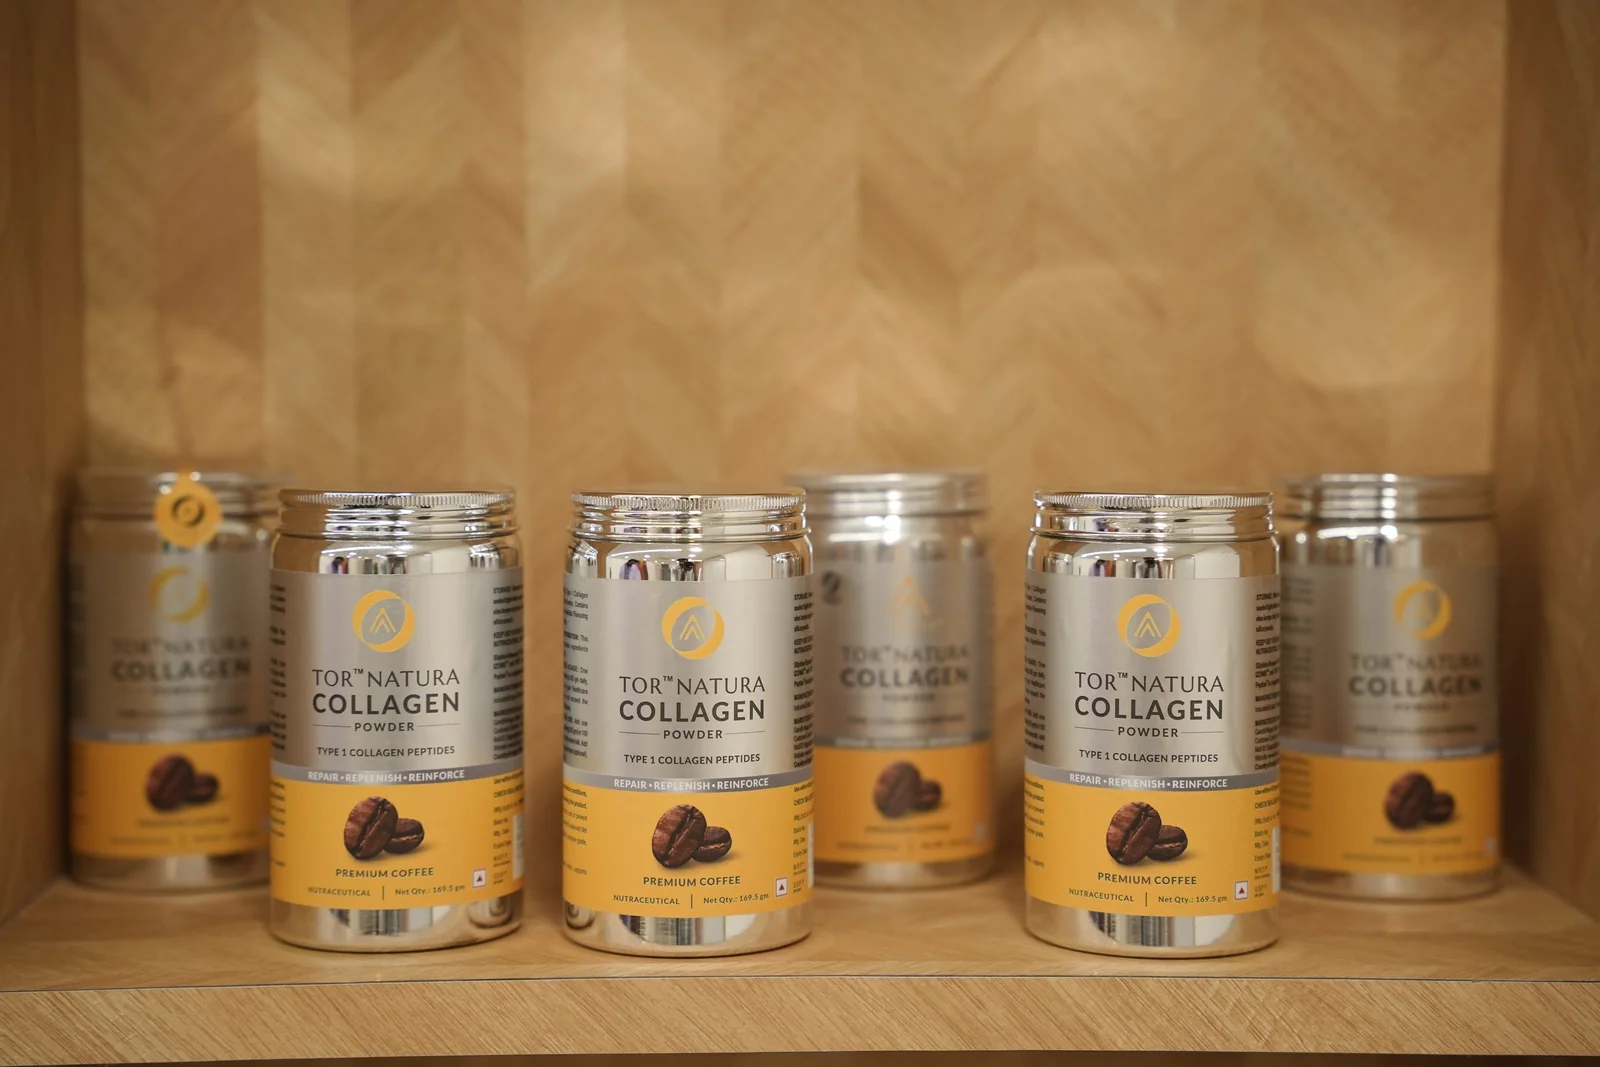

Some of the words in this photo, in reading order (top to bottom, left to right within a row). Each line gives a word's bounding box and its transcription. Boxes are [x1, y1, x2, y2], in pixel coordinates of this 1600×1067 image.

[368, 668, 460, 687] NATURA
[1132, 676, 1224, 692] NATURA
[677, 676, 765, 694] NATURA
[313, 692, 459, 714] COLLAGEN
[1075, 696, 1223, 720] COLLAGEN
[620, 700, 764, 722] COLLAGEN
[354, 722, 414, 732] POWDER
[1118, 727, 1178, 737] POWDER
[664, 730, 723, 739] POWDER
[317, 747, 339, 756] TYPE
[342, 748, 346, 756] 1
[350, 748, 404, 757] COLLAGEN
[408, 746, 455, 756] PEPTIDES
[1079, 749, 1102, 759] TYPE
[1105, 752, 1110, 760] 1
[1113, 752, 1168, 762] COLLAGEN
[1171, 754, 1218, 762] PEPTIDES
[624, 754, 647, 763] TYPE
[650, 756, 655, 764] 1
[658, 756, 713, 764] COLLAGEN
[716, 754, 760, 764] PEPTIDES
[308, 772, 339, 782] REPAIR
[346, 773, 402, 783] REPLENISH
[409, 770, 465, 782] REINFORCE
[1070, 773, 1101, 784] REPAIR
[1109, 778, 1165, 788] REPLENISH
[1172, 779, 1228, 789] REINFORCE
[614, 778, 646, 789] REPAIR
[654, 781, 710, 790] REPLENISH
[717, 778, 769, 789] REINFORCE
[336, 868, 388, 878] PREMIUM
[392, 867, 434, 878] COFFEE
[1098, 872, 1151, 884] PREMIUM
[1154, 876, 1197, 885] COFFEE
[643, 876, 696, 886] PREMIUM
[700, 876, 740, 886] COFFEE
[308, 887, 370, 896] NUTRACEUTICAL
[395, 888, 409, 896] Net
[433, 885, 453, 894] 169.5
[454, 885, 465, 893] gm
[1069, 888, 1134, 902] NUTRACEUTICAL
[613, 894, 679, 904] NUTRACEUTICAL
[740, 894, 758, 902] 169.5
